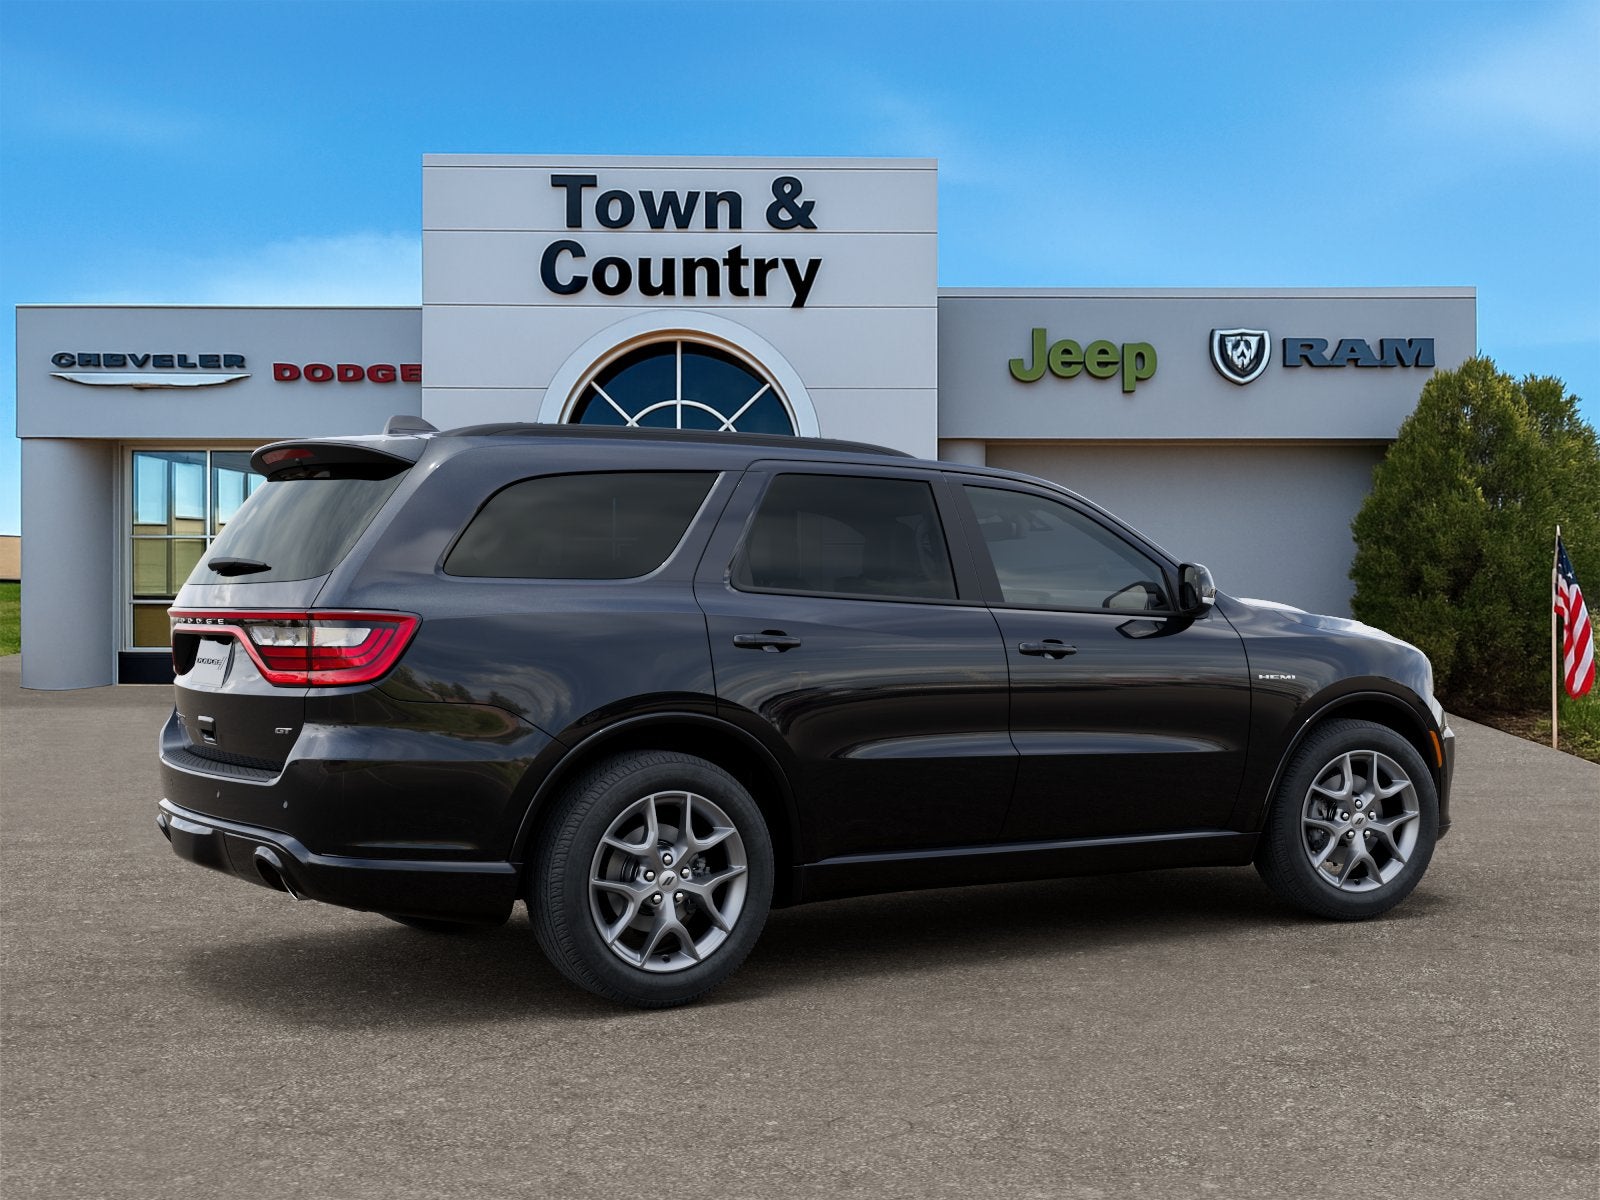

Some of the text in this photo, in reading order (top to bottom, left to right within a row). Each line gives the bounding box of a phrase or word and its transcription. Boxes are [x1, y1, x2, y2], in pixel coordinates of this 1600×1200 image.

[550, 174, 818, 230] Town &
[540, 239, 823, 308] Country
[273, 363, 422, 383] DODGE
[1009, 328, 1157, 393] Jeep
[1282, 337, 1435, 368] RAM
[274, 727, 293, 735] GT
